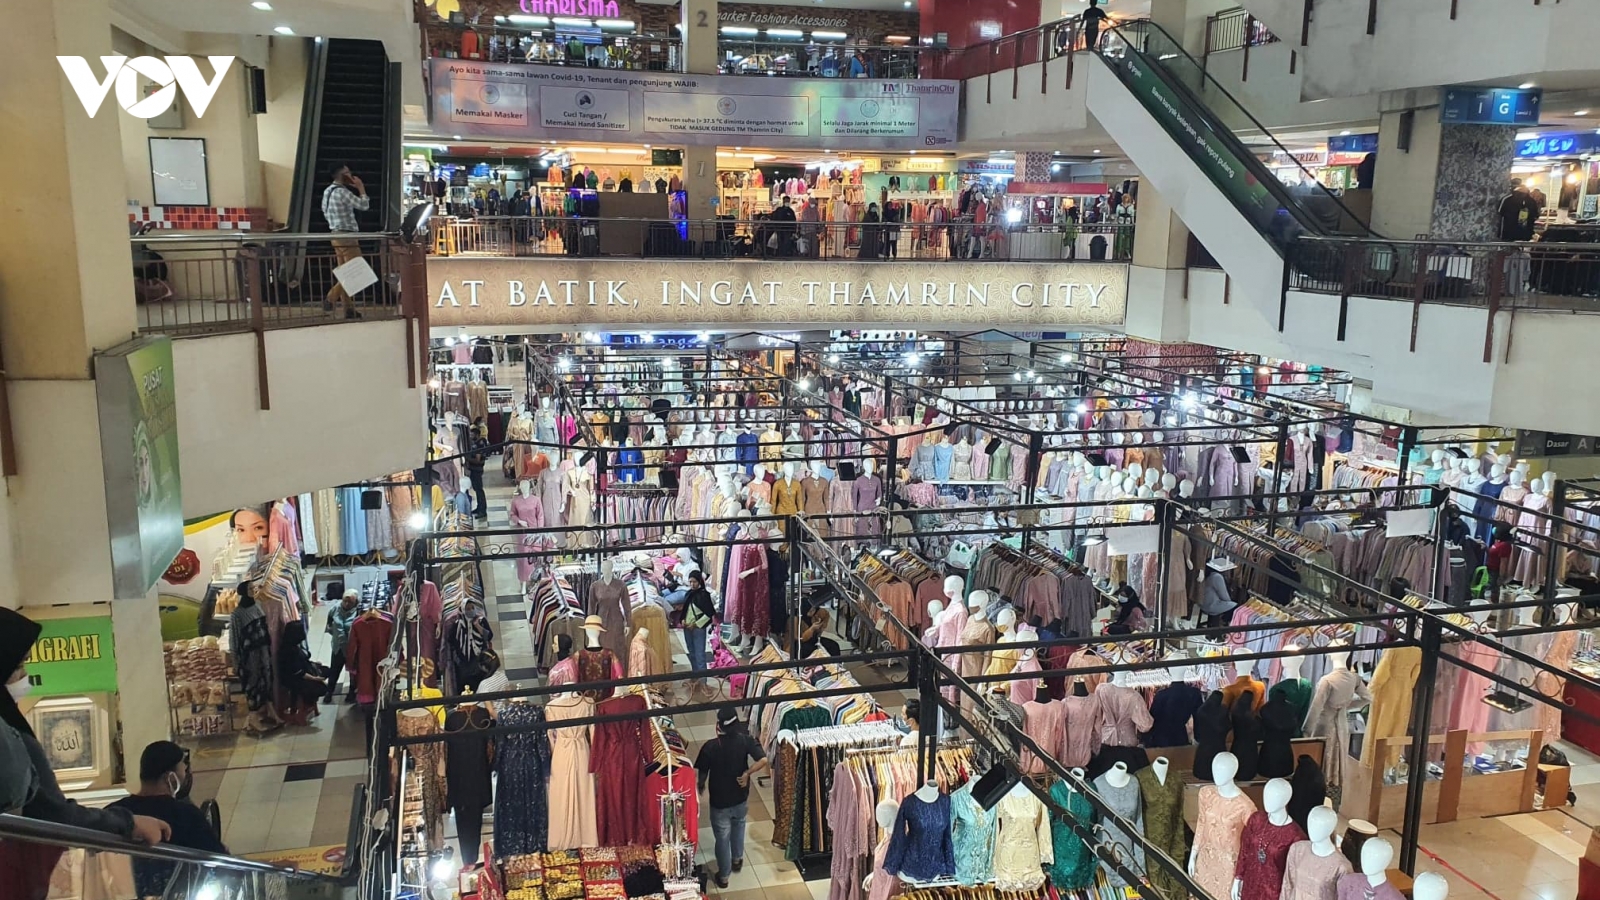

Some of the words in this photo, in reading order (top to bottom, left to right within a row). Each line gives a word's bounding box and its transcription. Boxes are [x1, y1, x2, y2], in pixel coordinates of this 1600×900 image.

[519, 0, 619, 17] CHARISMA
[695, 10, 708, 27] 2
[750, 12, 786, 24] Fashion
[789, 15, 848, 27] Accessories
[449, 65, 464, 74] Ayo
[466, 66, 480, 74] kita
[482, 69, 525, 78] sama-sama
[526, 71, 549, 80] lawan
[551, 73, 586, 83] Covid-19,
[588, 75, 612, 84] Tenant
[613, 77, 628, 85] dan
[629, 79, 672, 88] pengunjung
[674, 80, 699, 88] WAJIB:
[455, 109, 492, 118] Memakai
[494, 111, 523, 119] Masker
[578, 112, 602, 120] Tangan
[1499, 103, 1509, 114] G
[545, 119, 577, 127] Memakai
[578, 120, 596, 128] Hand
[596, 121, 625, 129] Sanitizer
[1217, 157, 1235, 179] pulang
[435, 280, 485, 307] AT
[507, 280, 639, 308] BATIK,
[661, 280, 784, 306] INGAT
[802, 282, 990, 307] THAMRIN
[1011, 282, 1108, 307] CITY
[143, 365, 163, 391] PUSAT
[1546, 439, 1570, 448] Dasar
[1577, 437, 1588, 449] A
